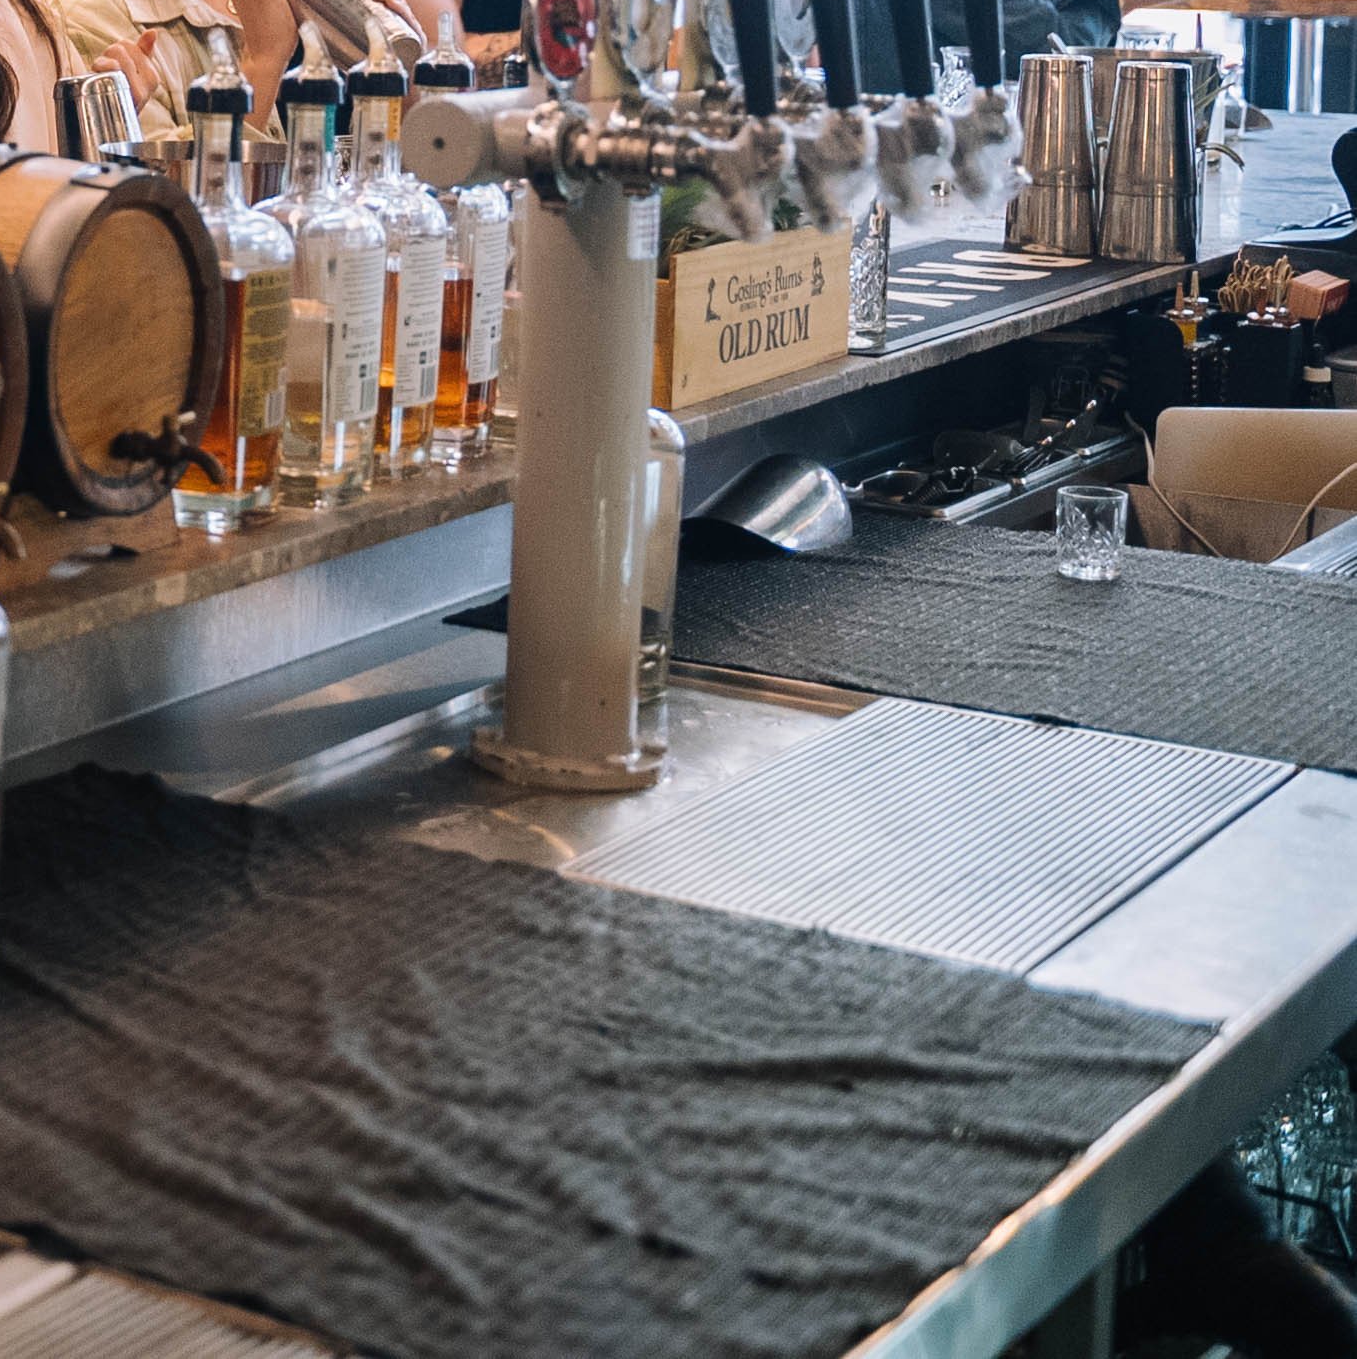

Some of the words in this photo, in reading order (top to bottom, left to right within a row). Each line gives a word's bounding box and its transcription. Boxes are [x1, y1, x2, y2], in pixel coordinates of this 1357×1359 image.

[727, 272, 773, 308] Gosling's
[775, 265, 804, 293] Rums
[719, 318, 763, 364] OLD
[764, 304, 811, 351] RUM
